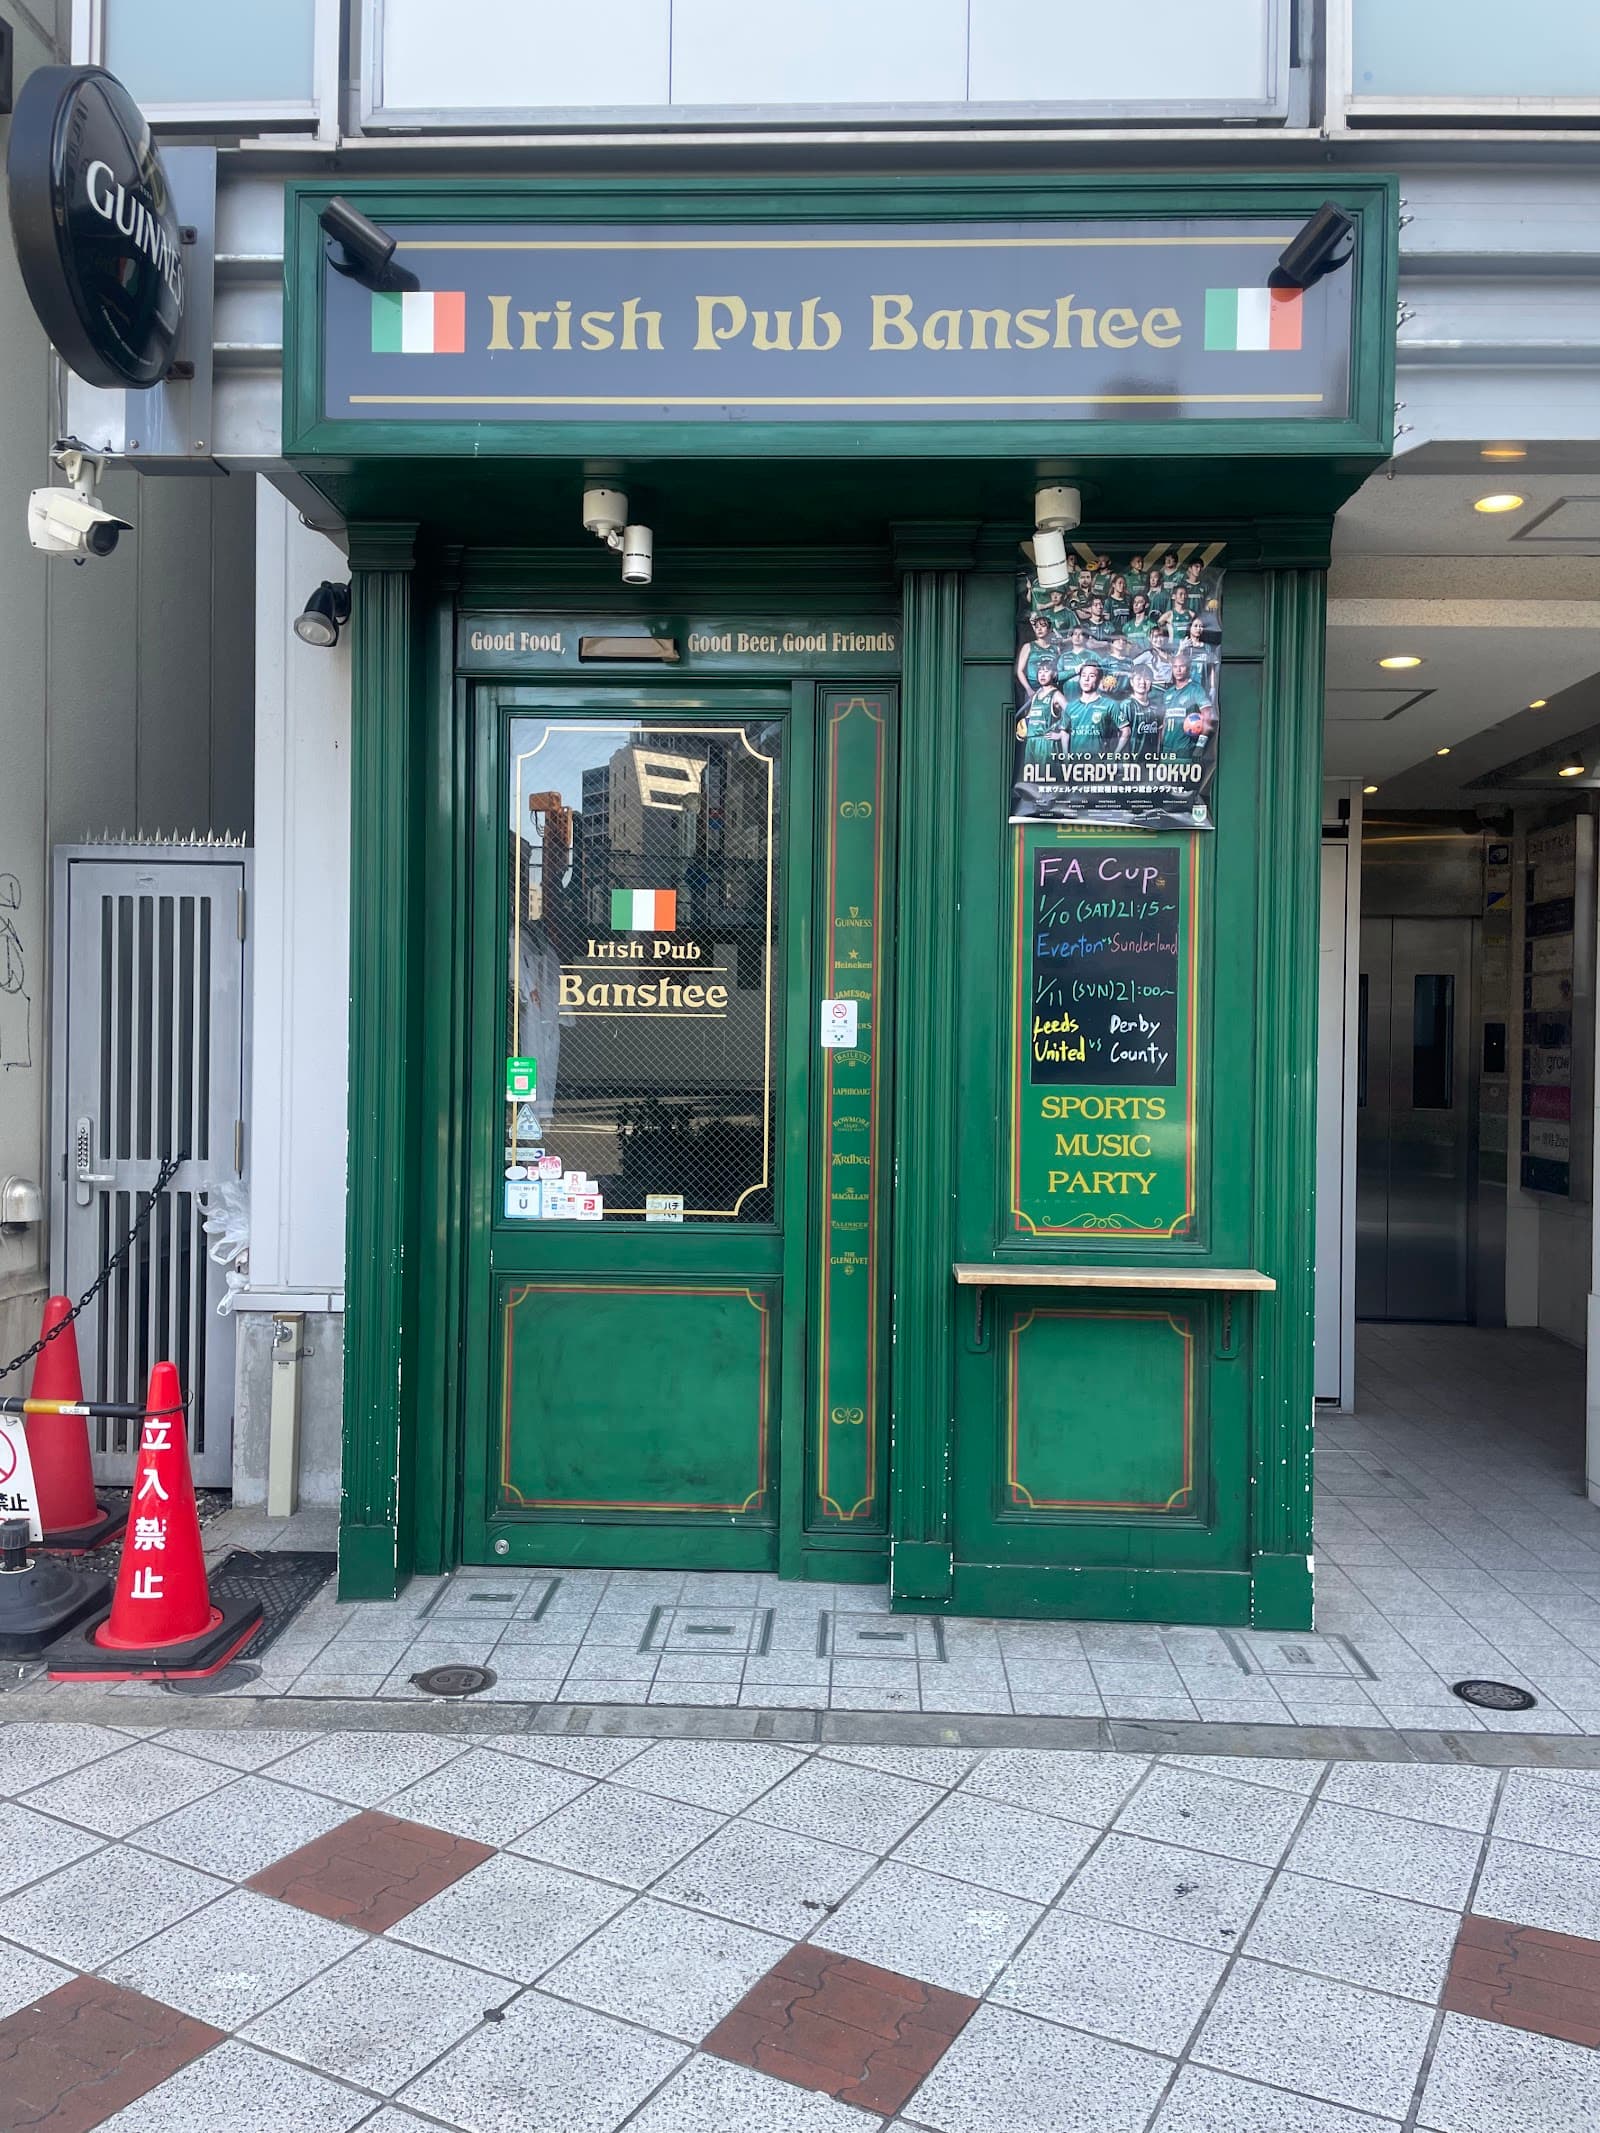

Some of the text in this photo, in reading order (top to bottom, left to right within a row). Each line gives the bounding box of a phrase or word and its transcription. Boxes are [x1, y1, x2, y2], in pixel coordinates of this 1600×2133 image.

[486, 293, 1183, 351] Irish Pub Banshee
[470, 631, 567, 655] Good Food,
[687, 632, 733, 653] Good
[832, 631, 896, 652] Friends
[1051, 752, 1178, 761] TOKYO VERDY CLUB
[1023, 763, 1202, 783] ALL VERDY IN TOKYO
[1039, 857, 1159, 895] FA Cup
[834, 917, 873, 928] GUINNESS
[1038, 894, 1070, 928] 1/10
[586, 939, 701, 960] Irish Pub
[1037, 932, 1104, 958] Everton
[1110, 931, 1178, 955] Sunderland
[834, 960, 873, 969] Heineken
[558, 974, 728, 1008] Banshee
[833, 989, 872, 1001] JAMESON
[1035, 975, 1063, 1007] 1/11
[1033, 1011, 1161, 1042] Leeds Derby
[1034, 1034, 1086, 1063] United
[1110, 1041, 1169, 1073] County
[1040, 1096, 1167, 1120] SPORTS
[1054, 1133, 1152, 1157] MUSIC
[1047, 1170, 1158, 1194] PARTY
[830, 1256, 869, 1265] GLENLIVET
[130, 1418, 172, 1600] 立入禁止
